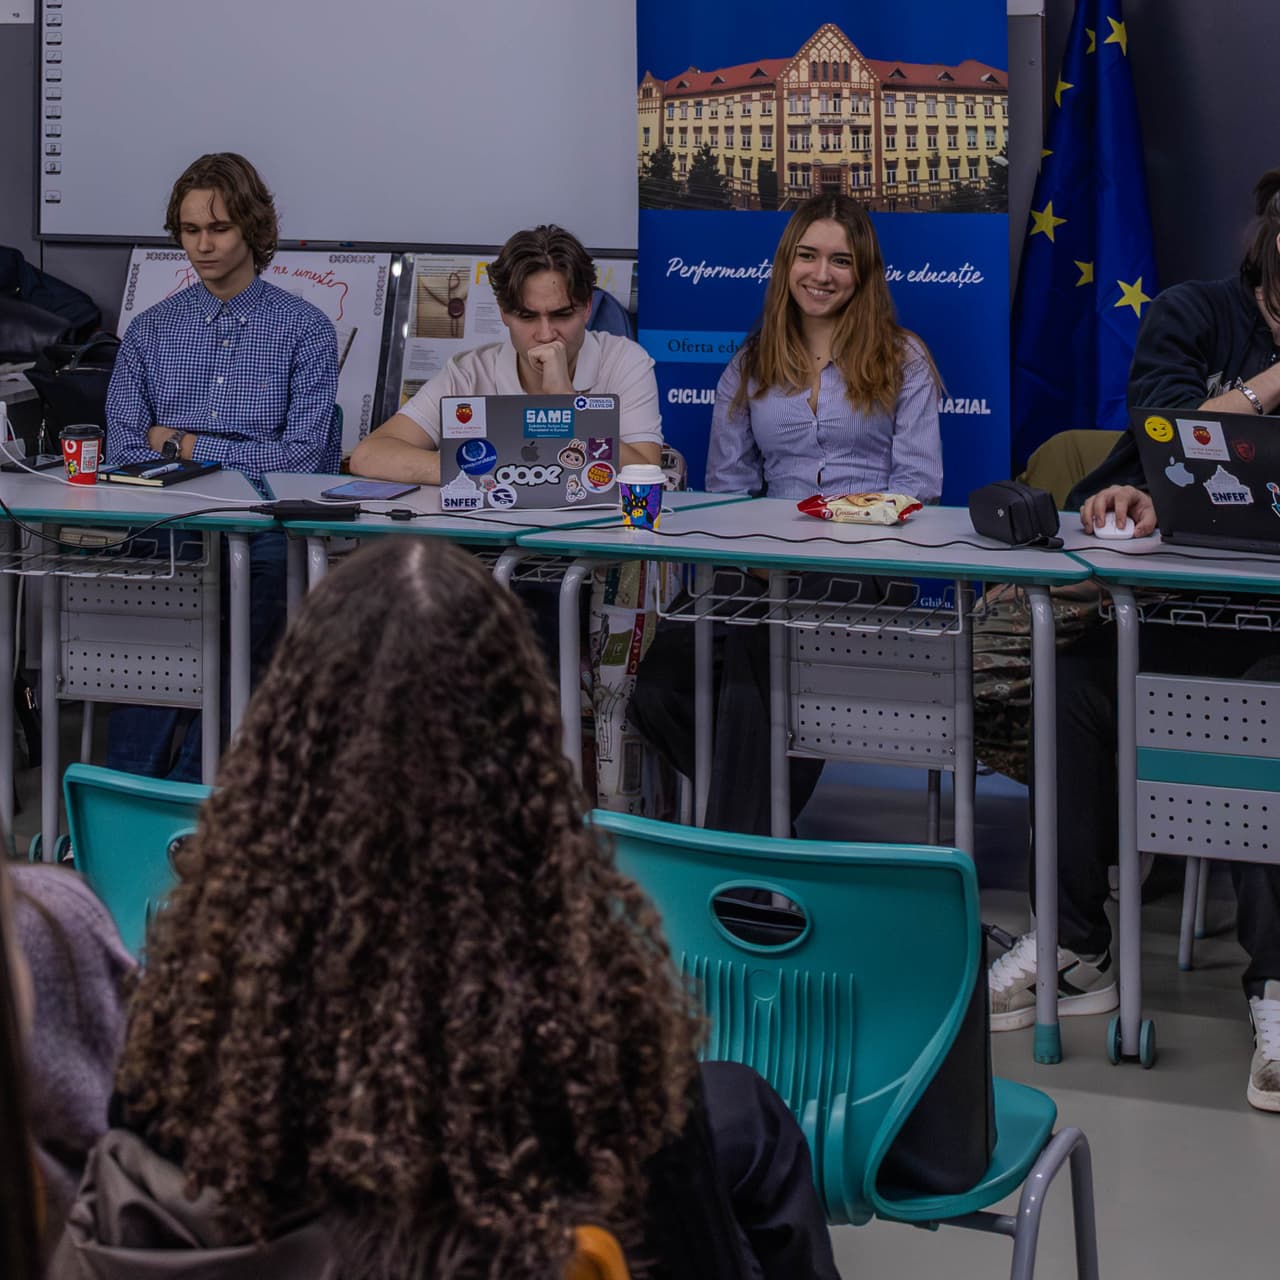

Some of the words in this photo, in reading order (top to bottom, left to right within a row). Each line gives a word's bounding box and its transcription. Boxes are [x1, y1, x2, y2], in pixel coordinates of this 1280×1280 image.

[907, 262, 985, 289] educație
[667, 338, 713, 353] Oferta
[526, 410, 571, 423] SAME
[496, 464, 562, 486] dope
